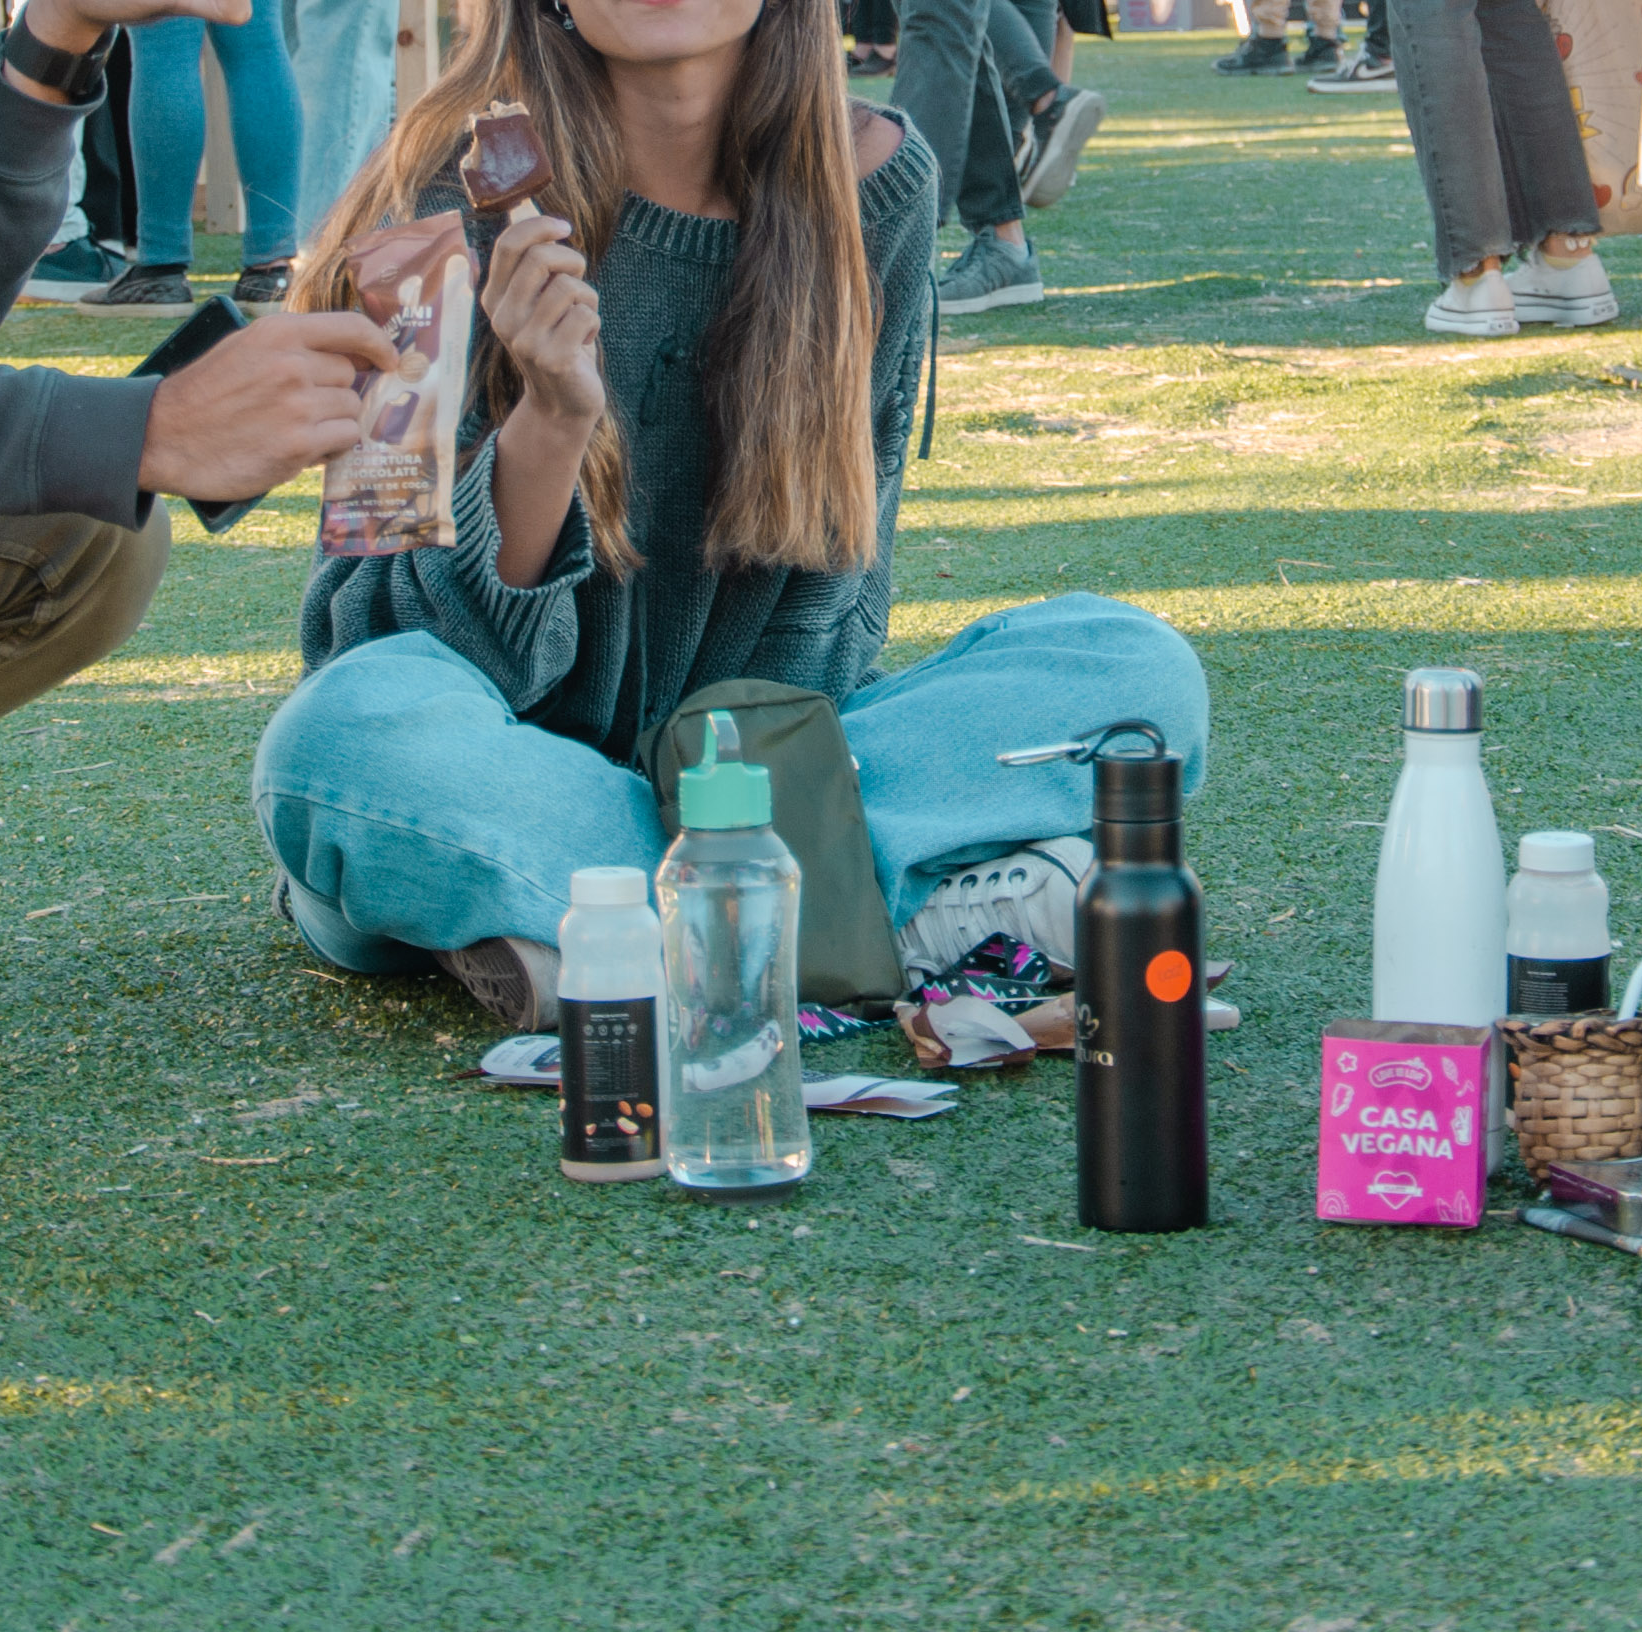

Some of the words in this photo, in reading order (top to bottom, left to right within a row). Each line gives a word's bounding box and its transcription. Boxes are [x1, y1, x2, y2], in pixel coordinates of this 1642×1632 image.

[402, 480, 430, 489] COCO
[1360, 1106, 1438, 1132] CASA
[1341, 1132, 1454, 1160] VEGANA
